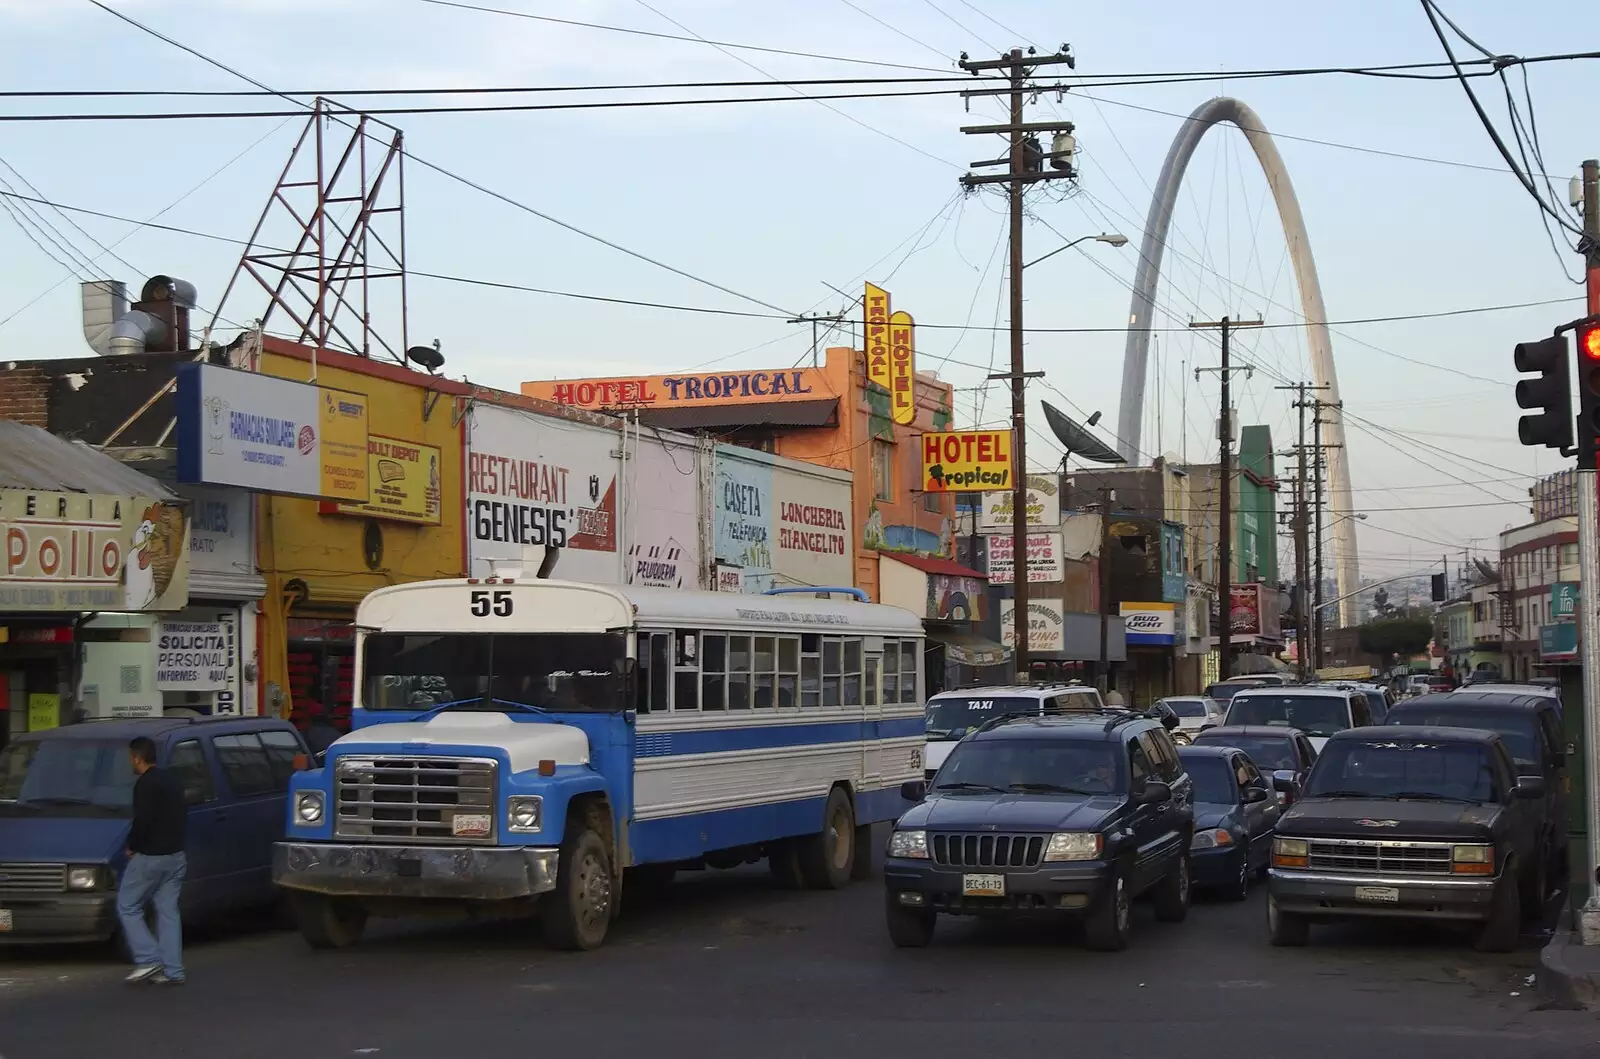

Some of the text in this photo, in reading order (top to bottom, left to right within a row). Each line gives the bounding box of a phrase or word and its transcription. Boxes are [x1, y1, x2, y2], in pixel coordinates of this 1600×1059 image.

[870, 297, 886, 376] TROPICAL
[893, 329, 910, 407] HOTEL
[552, 371, 812, 405] HOTEL TROPICAL
[925, 434, 1008, 464] HOTEL
[470, 452, 569, 505] RESTAURANT
[724, 481, 761, 517] CASETA
[781, 502, 846, 530] LONCHERIA
[471, 591, 513, 617] 55
[1126, 621, 1164, 629] LIGHT
[158, 635, 226, 650] SOLICITA
[158, 652, 226, 668] PERSONAL
[967, 700, 994, 710] TAXI
[1339, 840, 1418, 848] DODGE
